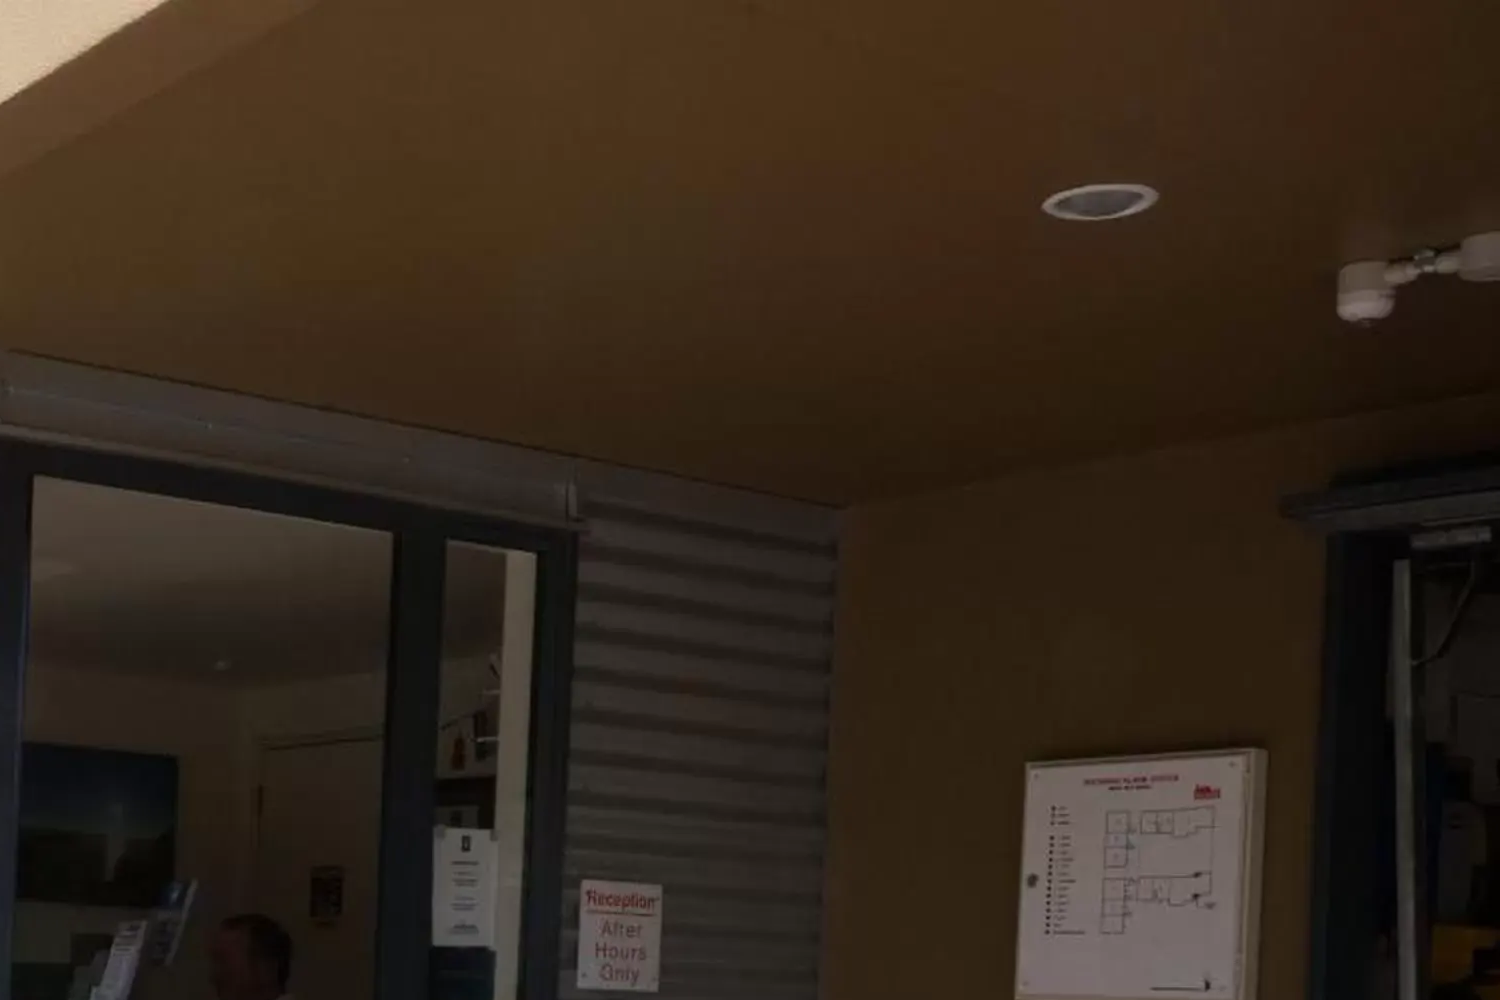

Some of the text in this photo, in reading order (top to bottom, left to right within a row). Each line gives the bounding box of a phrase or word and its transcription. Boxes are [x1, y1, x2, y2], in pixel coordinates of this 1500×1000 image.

[586, 889, 658, 911] Reception
[601, 920, 643, 938] After
[595, 942, 647, 961] Hours
[600, 963, 640, 985] Only
